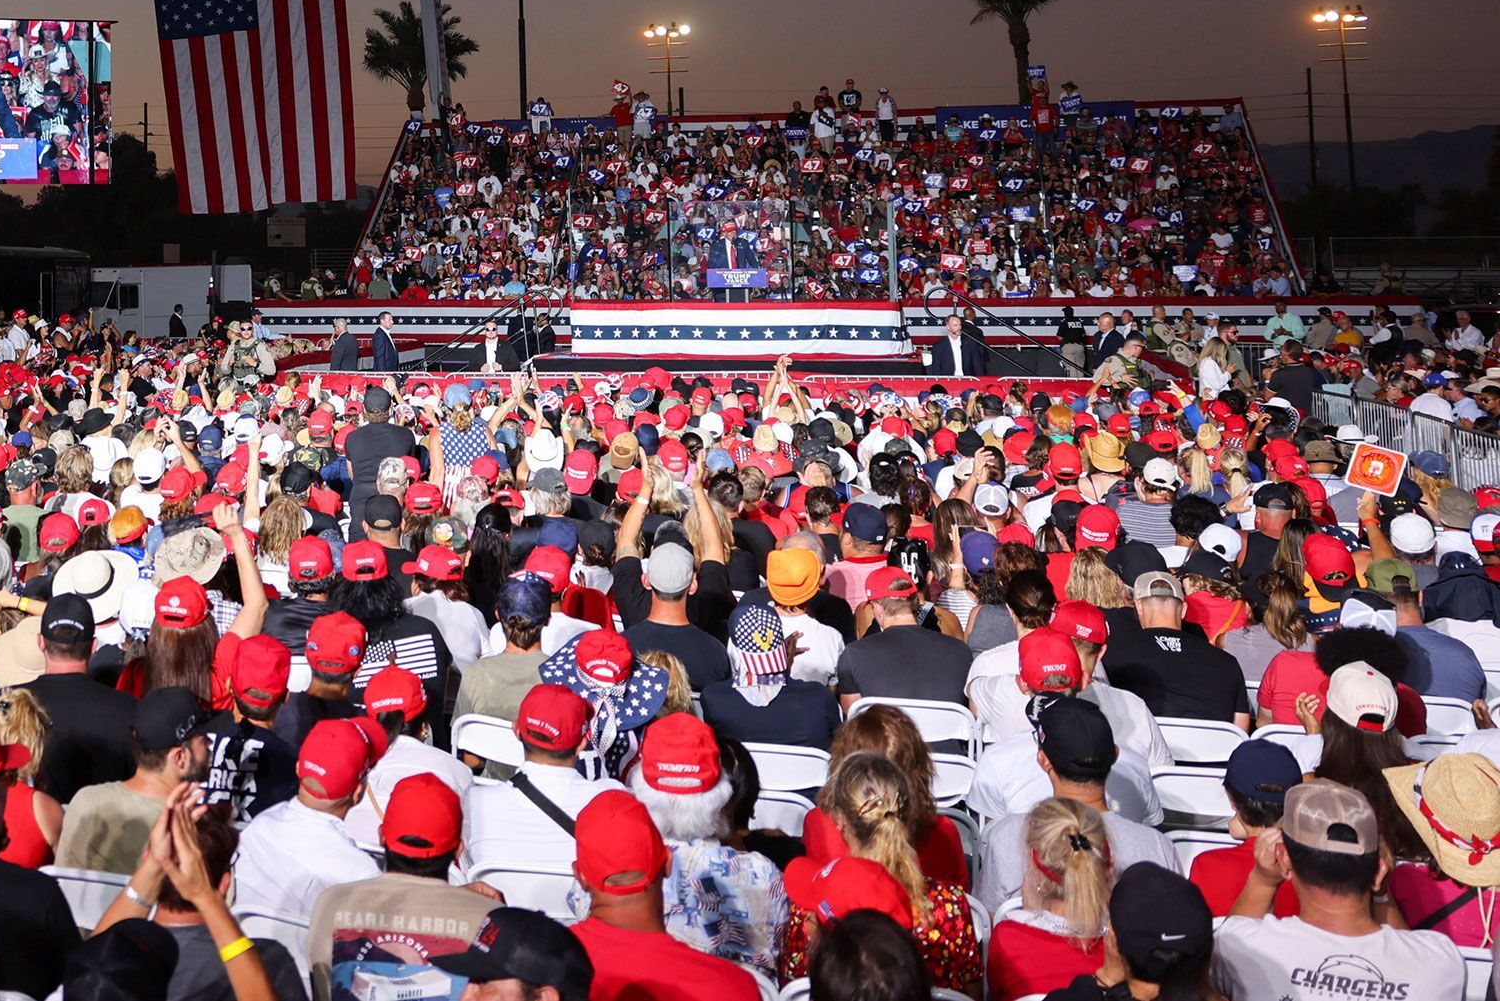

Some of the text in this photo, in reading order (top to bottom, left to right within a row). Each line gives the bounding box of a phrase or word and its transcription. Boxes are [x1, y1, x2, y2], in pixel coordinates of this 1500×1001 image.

[614, 82, 629, 93] 47
[532, 104, 546, 114] 47
[638, 108, 652, 118] 47
[1162, 108, 1179, 117] 47
[451, 114, 462, 126] 47
[408, 122, 421, 132] 47
[467, 124, 481, 135] 47
[488, 135, 501, 145] 47
[513, 134, 526, 144] 47
[980, 130, 996, 140] 47
[747, 136, 761, 146] 47
[1195, 144, 1212, 154] 47
[855, 150, 872, 160] 47
[463, 158, 476, 167] 47
[556, 157, 569, 167] 47
[804, 160, 820, 170] 47
[969, 156, 983, 166] 47
[1110, 157, 1125, 166] 47
[1131, 160, 1148, 170] 47
[607, 162, 622, 172] 47
[589, 169, 605, 181] 47
[925, 176, 942, 186] 47
[952, 179, 968, 189] 47
[1006, 179, 1023, 189] 47
[458, 184, 473, 194] 47
[707, 187, 724, 197] 47
[905, 202, 922, 213] 47
[1077, 200, 1095, 211] 47
[472, 210, 485, 220] 47
[646, 212, 664, 222] 47
[1104, 213, 1122, 222] 47
[1170, 211, 1183, 222] 47
[574, 217, 592, 227] 47
[698, 229, 714, 239] 47
[406, 249, 420, 259] 47
[443, 245, 457, 254] 47
[835, 256, 852, 266] 47
[863, 253, 879, 265] 47
[943, 257, 963, 268] 47
[899, 259, 918, 272] 47
[861, 270, 879, 281] 47
[808, 283, 823, 295] 47
[1042, 664, 1067, 673] TRUMP
[303, 760, 327, 776] TRUMP
[335, 911, 390, 929] PEARL
[392, 916, 469, 936] HARBOR
[355, 934, 429, 961] USS ARIZONA
[1291, 967, 1410, 1000] CHARGERS
